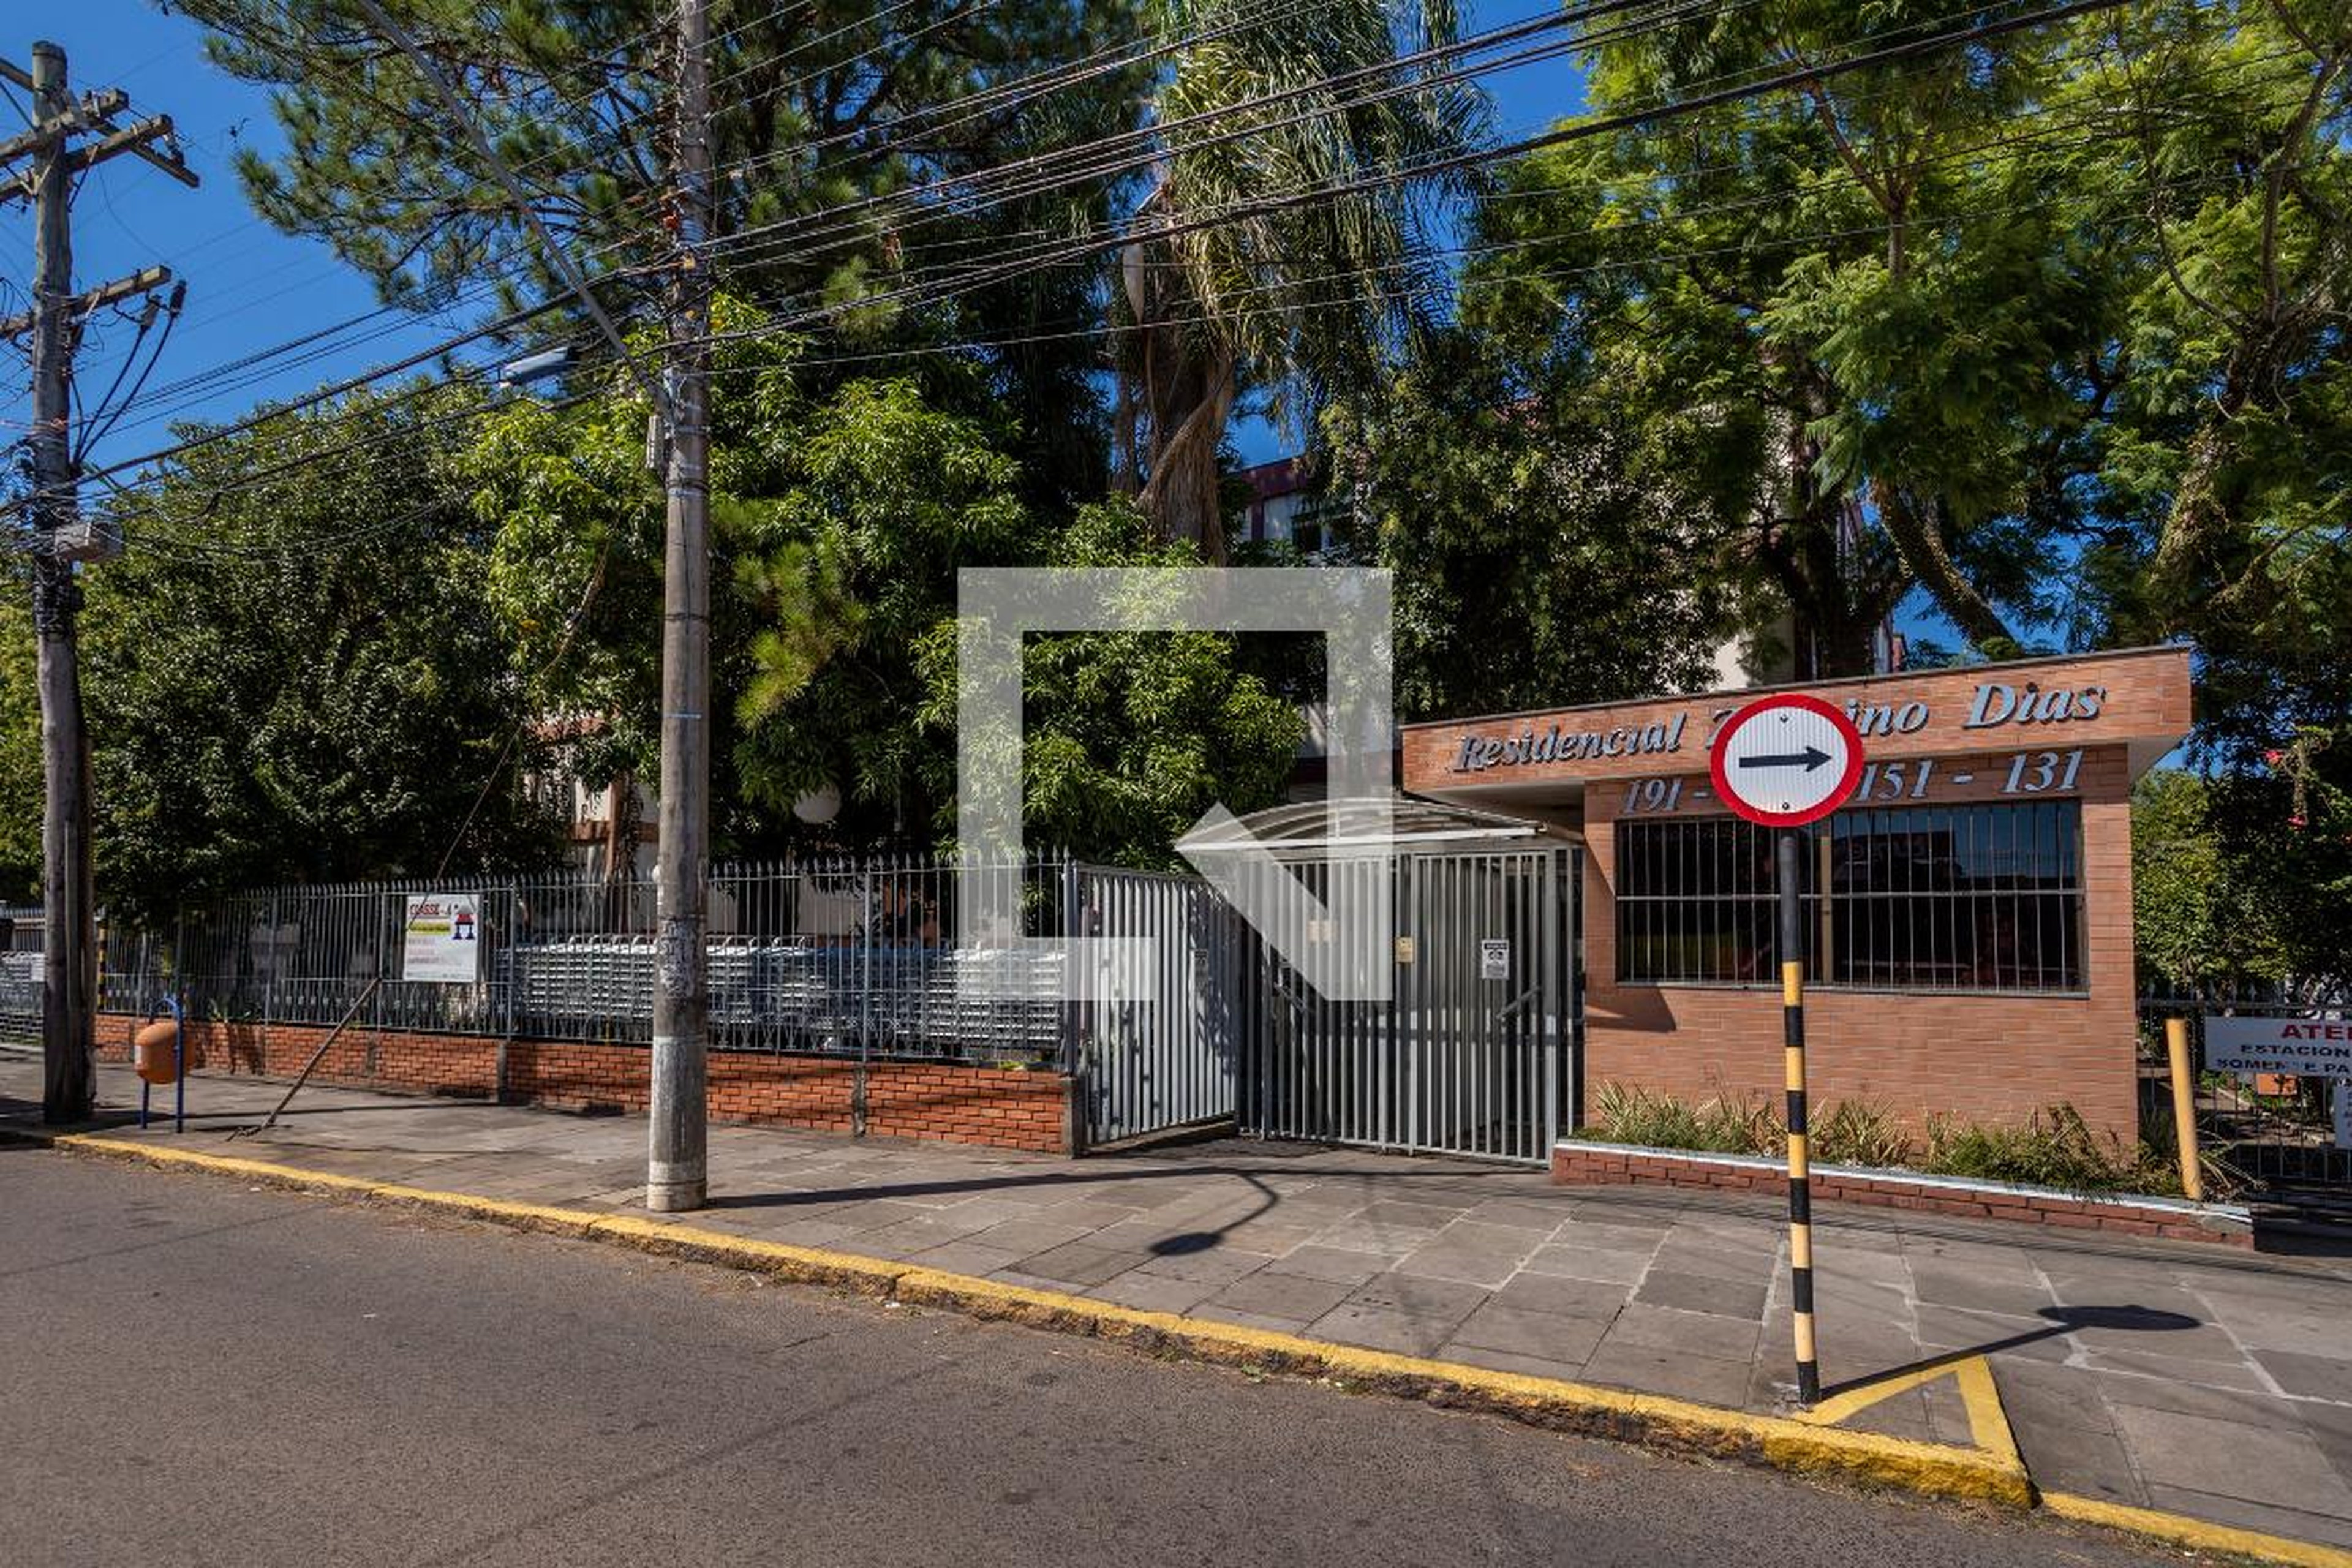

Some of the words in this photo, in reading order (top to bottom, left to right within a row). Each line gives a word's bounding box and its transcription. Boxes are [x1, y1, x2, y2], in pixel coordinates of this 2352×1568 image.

[1453, 711, 1687, 772] Residencial
[1962, 682, 2107, 729] Dias
[1625, 778, 1683, 815] 191
[1856, 759, 1932, 801] 151
[2000, 749, 2083, 794] 131
